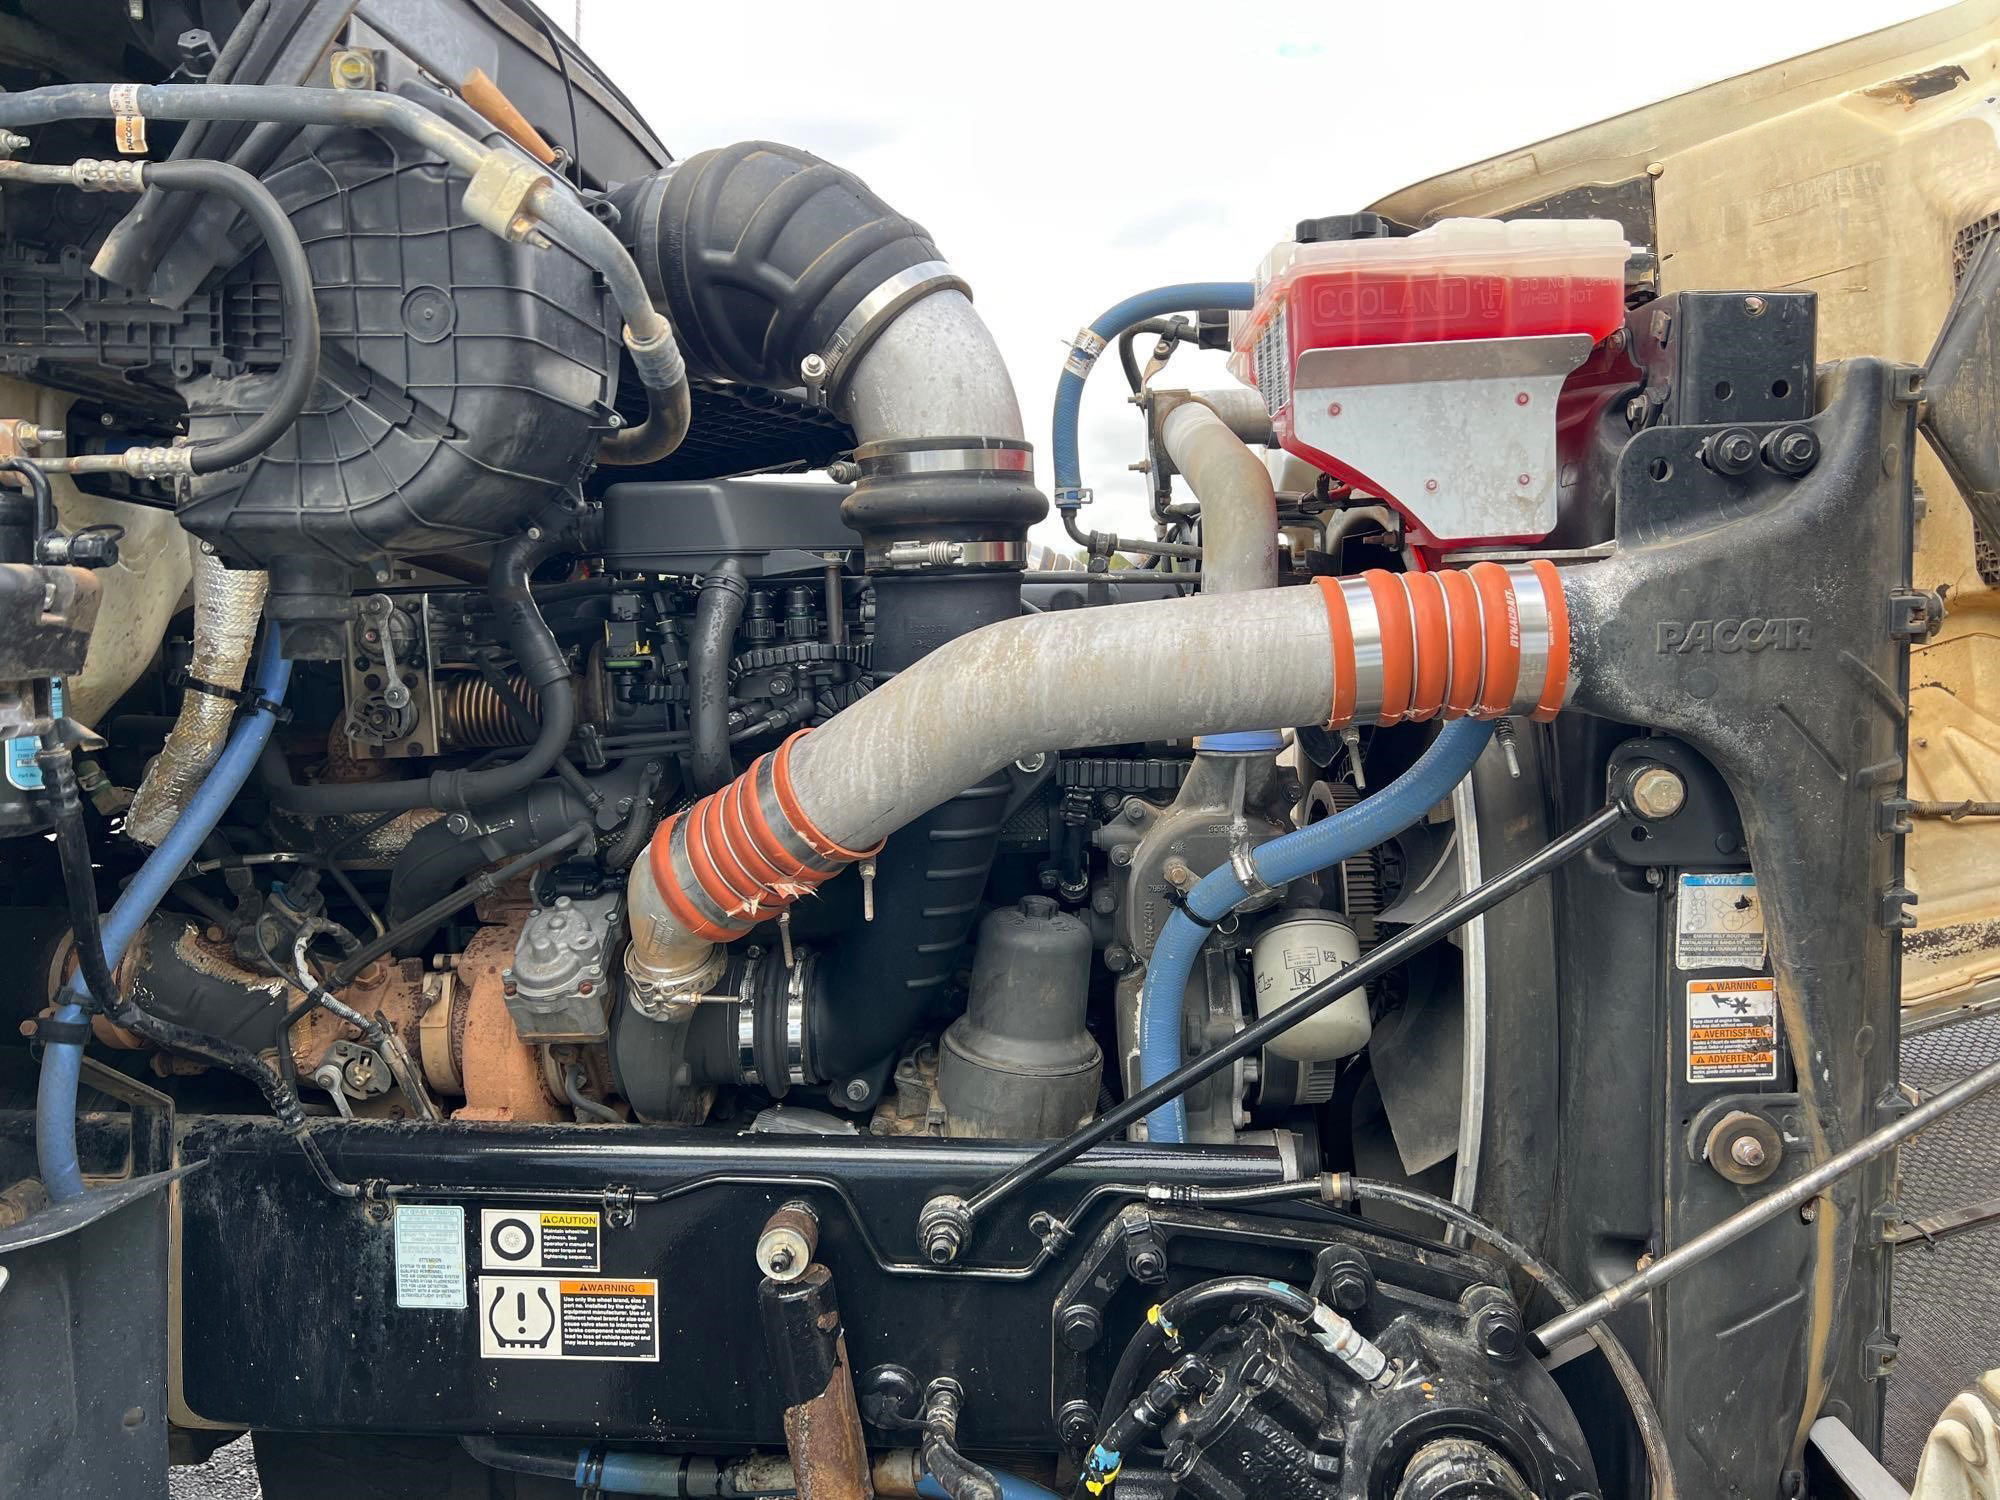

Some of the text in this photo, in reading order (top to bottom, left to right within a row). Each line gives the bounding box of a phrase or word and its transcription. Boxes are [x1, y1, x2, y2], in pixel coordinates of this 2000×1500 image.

[1316, 280, 1466, 319] COOLANT
[1521, 290, 1592, 304] WHEN HOT
[1656, 618, 1812, 654] PACCAR
[1705, 876, 1743, 884] NOTICE
[1717, 982, 1758, 991] WARNING
